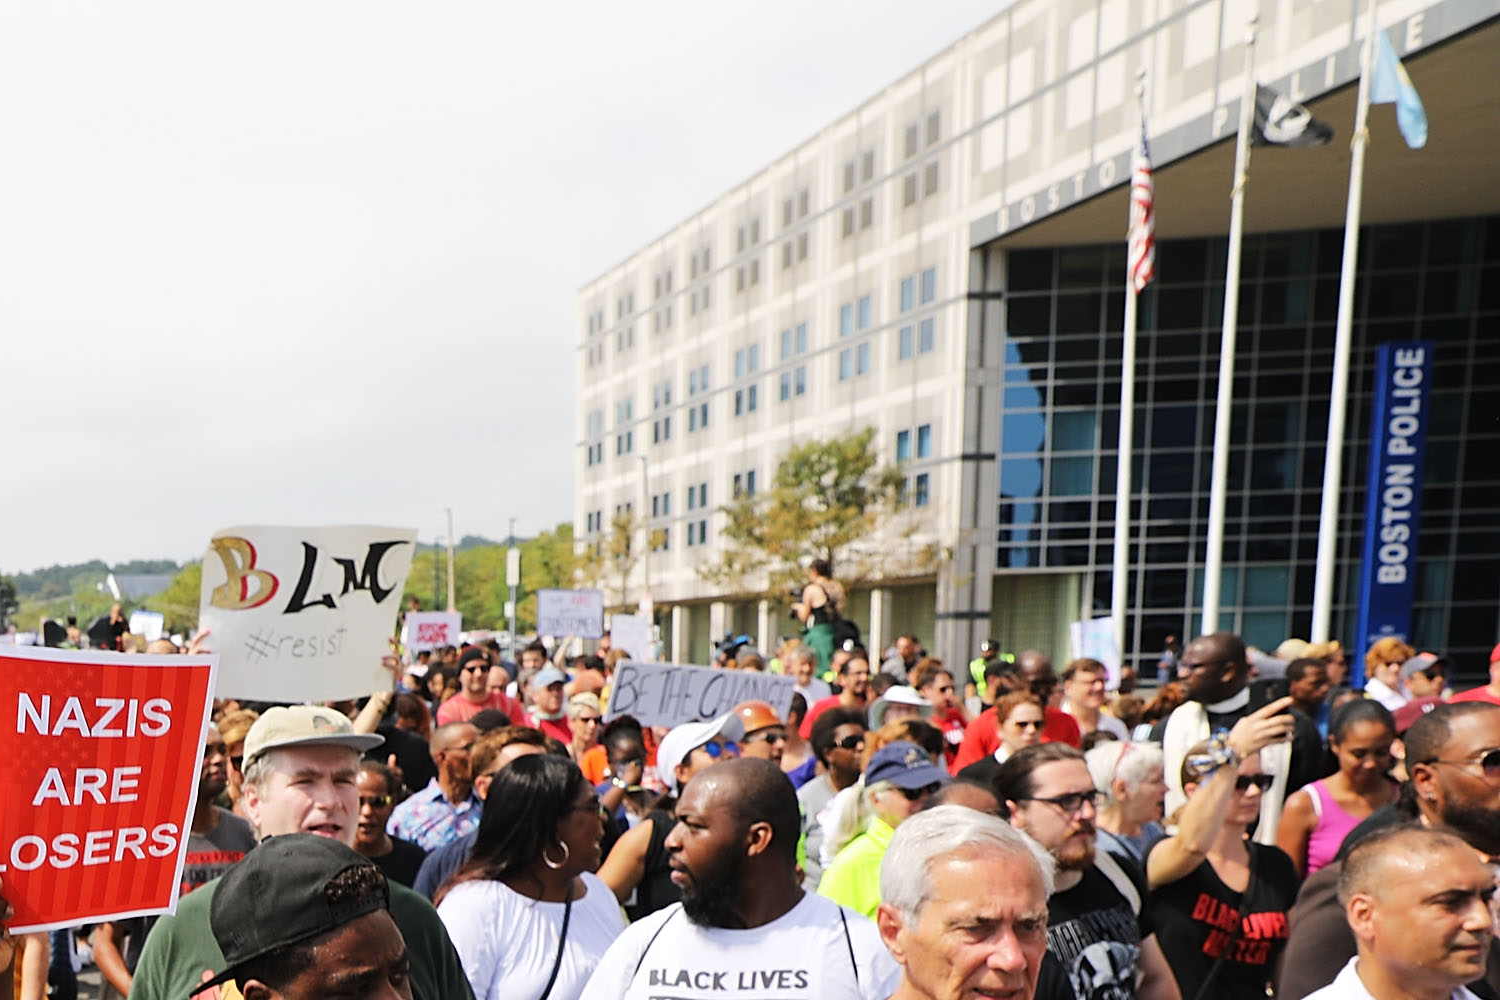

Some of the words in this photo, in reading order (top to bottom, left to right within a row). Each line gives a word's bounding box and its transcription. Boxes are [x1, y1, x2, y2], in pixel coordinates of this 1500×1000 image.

[997, 159, 1118, 234] BOSTO
[1387, 348, 1425, 455] POLICE
[1377, 464, 1415, 584] BOSTON
[244, 626, 348, 666] #resist
[16, 692, 173, 738] NAZIS
[612, 666, 652, 717] BE
[658, 667, 699, 720] THE
[32, 765, 143, 807] ARE
[1192, 893, 1239, 933] BLAC
[649, 969, 728, 991] BLACK
[738, 969, 809, 991] LIVES
